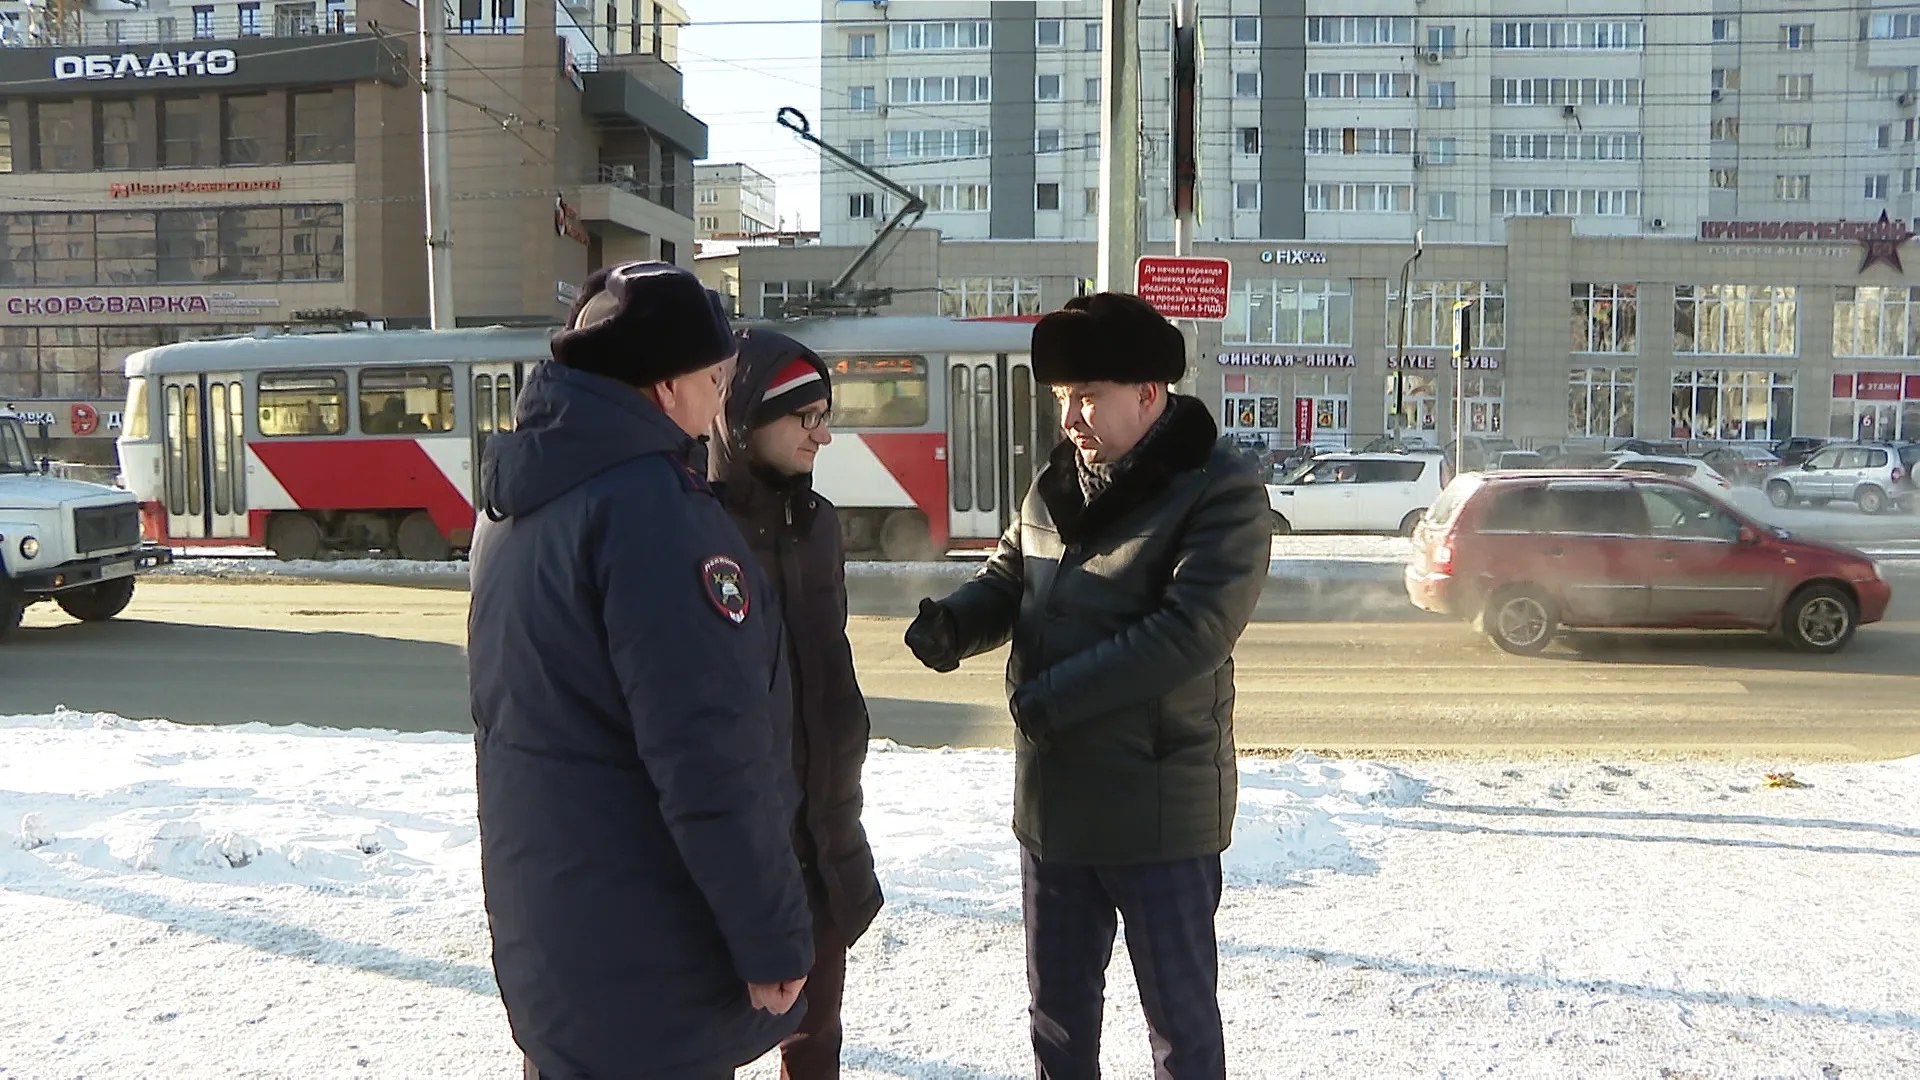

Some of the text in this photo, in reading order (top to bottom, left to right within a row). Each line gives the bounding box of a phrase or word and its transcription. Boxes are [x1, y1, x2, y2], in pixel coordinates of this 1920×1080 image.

[54, 49, 237, 80] ОБЛАКО
[1702, 219, 1905, 240] КРАСНОАРМЕЙСКИЙ
[1276, 249, 1304, 265] FIX
[1144, 265, 1223, 276] До начала перехода
[1152, 275, 1214, 284] пешеход обязан
[1185, 286, 1198, 294] что
[1199, 287, 1225, 296] выход
[7, 295, 209, 315] СКОРОВАРКА
[1157, 295, 1196, 304] проезжую
[1154, 304, 1180, 312] опасен
[1388, 355, 1435, 369] STYLE
[1867, 382, 1899, 391] ЭТАЖИ
[1863, 415, 1872, 426] 6
